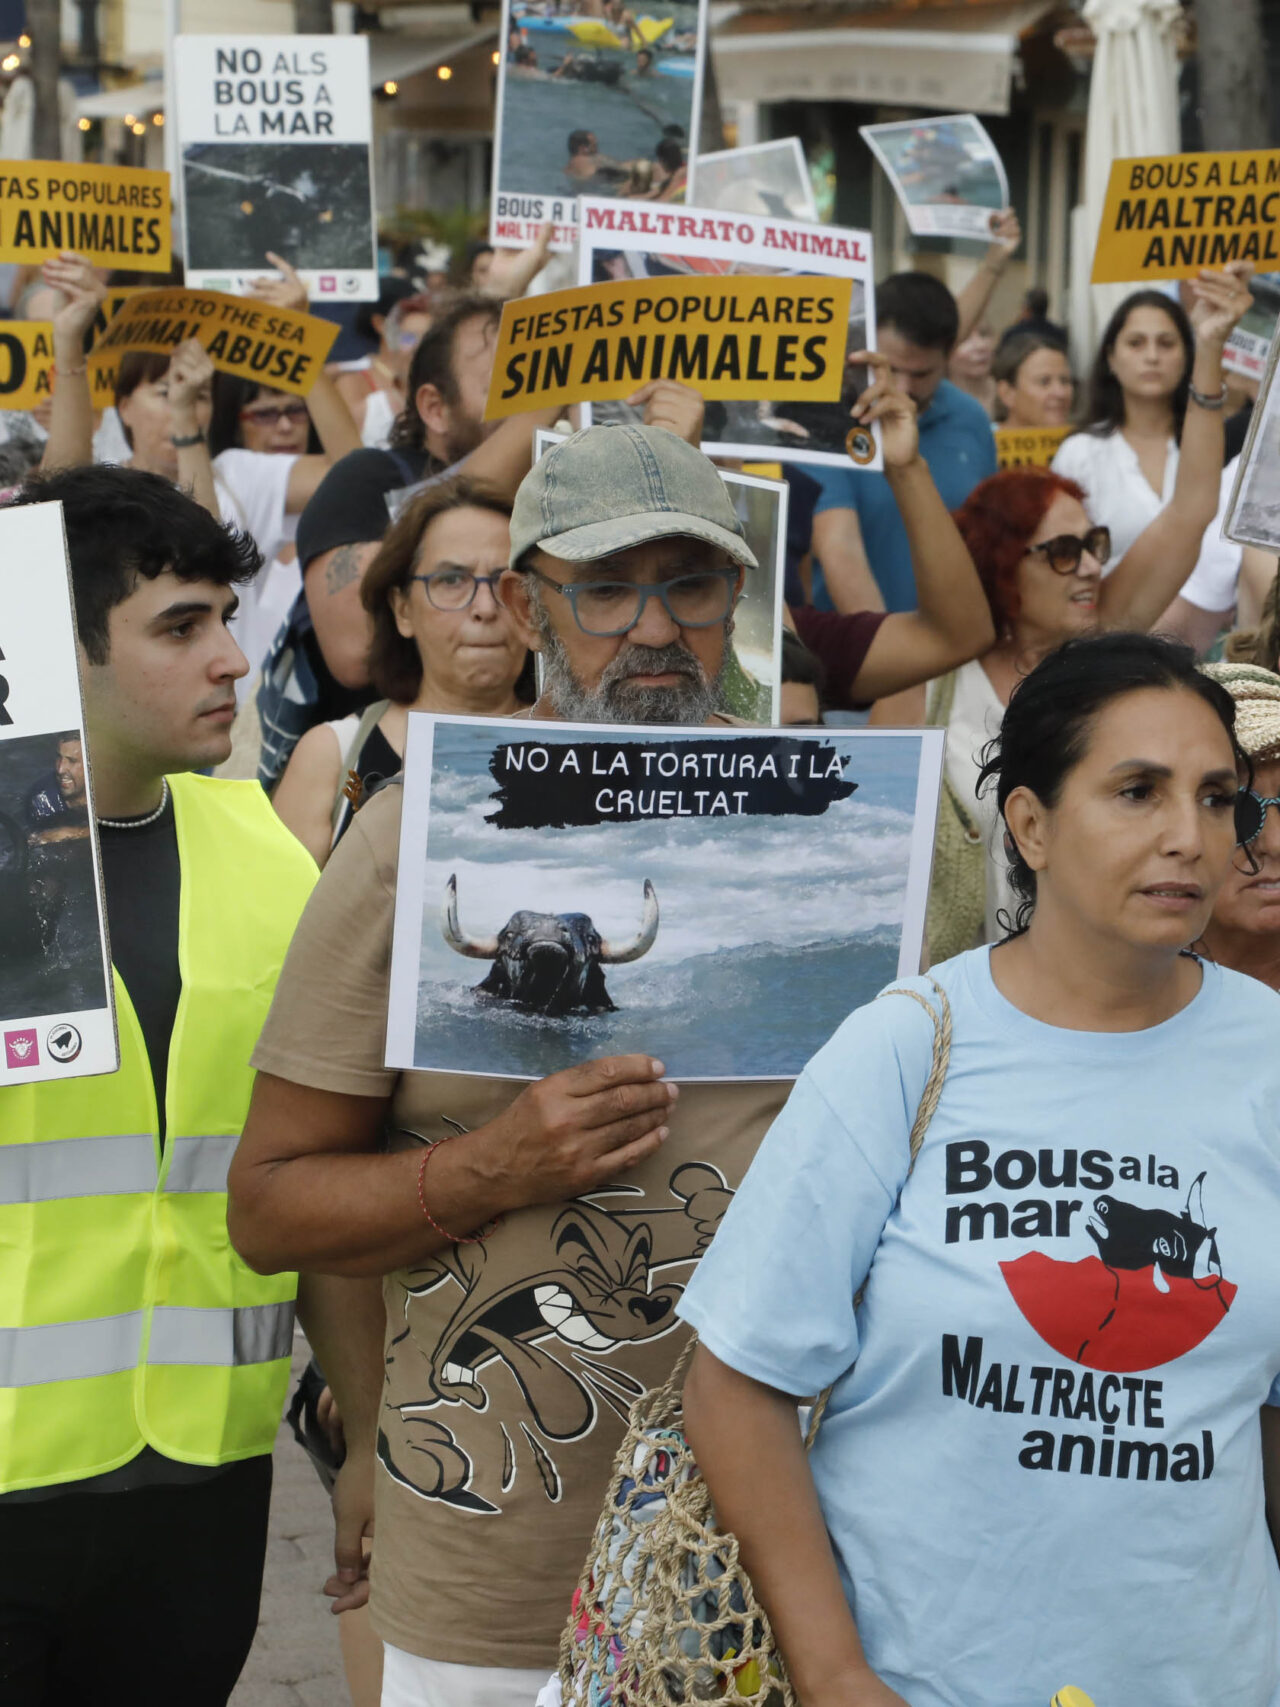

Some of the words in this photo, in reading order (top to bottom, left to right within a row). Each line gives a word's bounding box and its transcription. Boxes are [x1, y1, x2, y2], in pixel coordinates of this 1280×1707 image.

[216, 49, 262, 74] NO
[272, 52, 328, 76] ALS
[214, 81, 305, 105] BOUS
[313, 83, 333, 106] A
[214, 113, 250, 135] LA
[260, 111, 335, 135] MAR
[47, 178, 163, 209] POPULARES
[1129, 161, 1199, 191] BOUS
[1203, 161, 1222, 187] A
[1229, 159, 1259, 187] LA
[13, 209, 161, 255] ANIMALES
[497, 197, 545, 220] BOUS
[551, 201, 564, 222] A
[586, 207, 755, 245] MALTRATO
[762, 226, 867, 263] ANIMAL
[1142, 230, 1279, 269] ANIMAL
[189, 299, 217, 317] TO
[219, 303, 264, 331] THE
[262, 316, 306, 346] SEA
[509, 300, 626, 345] FIESTAS
[633, 296, 835, 325] POPULARES
[206, 328, 312, 386] ABUSE
[501, 343, 575, 399] SIN
[580, 333, 829, 382] ANIMALES
[505, 745, 549, 774] NO
[559, 748, 581, 775] A
[592, 750, 630, 777] LA
[640, 752, 778, 779] TORTURA
[787, 754, 801, 779] I
[808, 754, 844, 779] LA
[595, 788, 749, 816] CRUELTAT
[945, 1139, 1115, 1196] Bous
[1147, 1153, 1180, 1191] la
[945, 1198, 1083, 1245] mar
[941, 1333, 1165, 1429] MALTRACTE
[1017, 1425, 1215, 1483] animal
